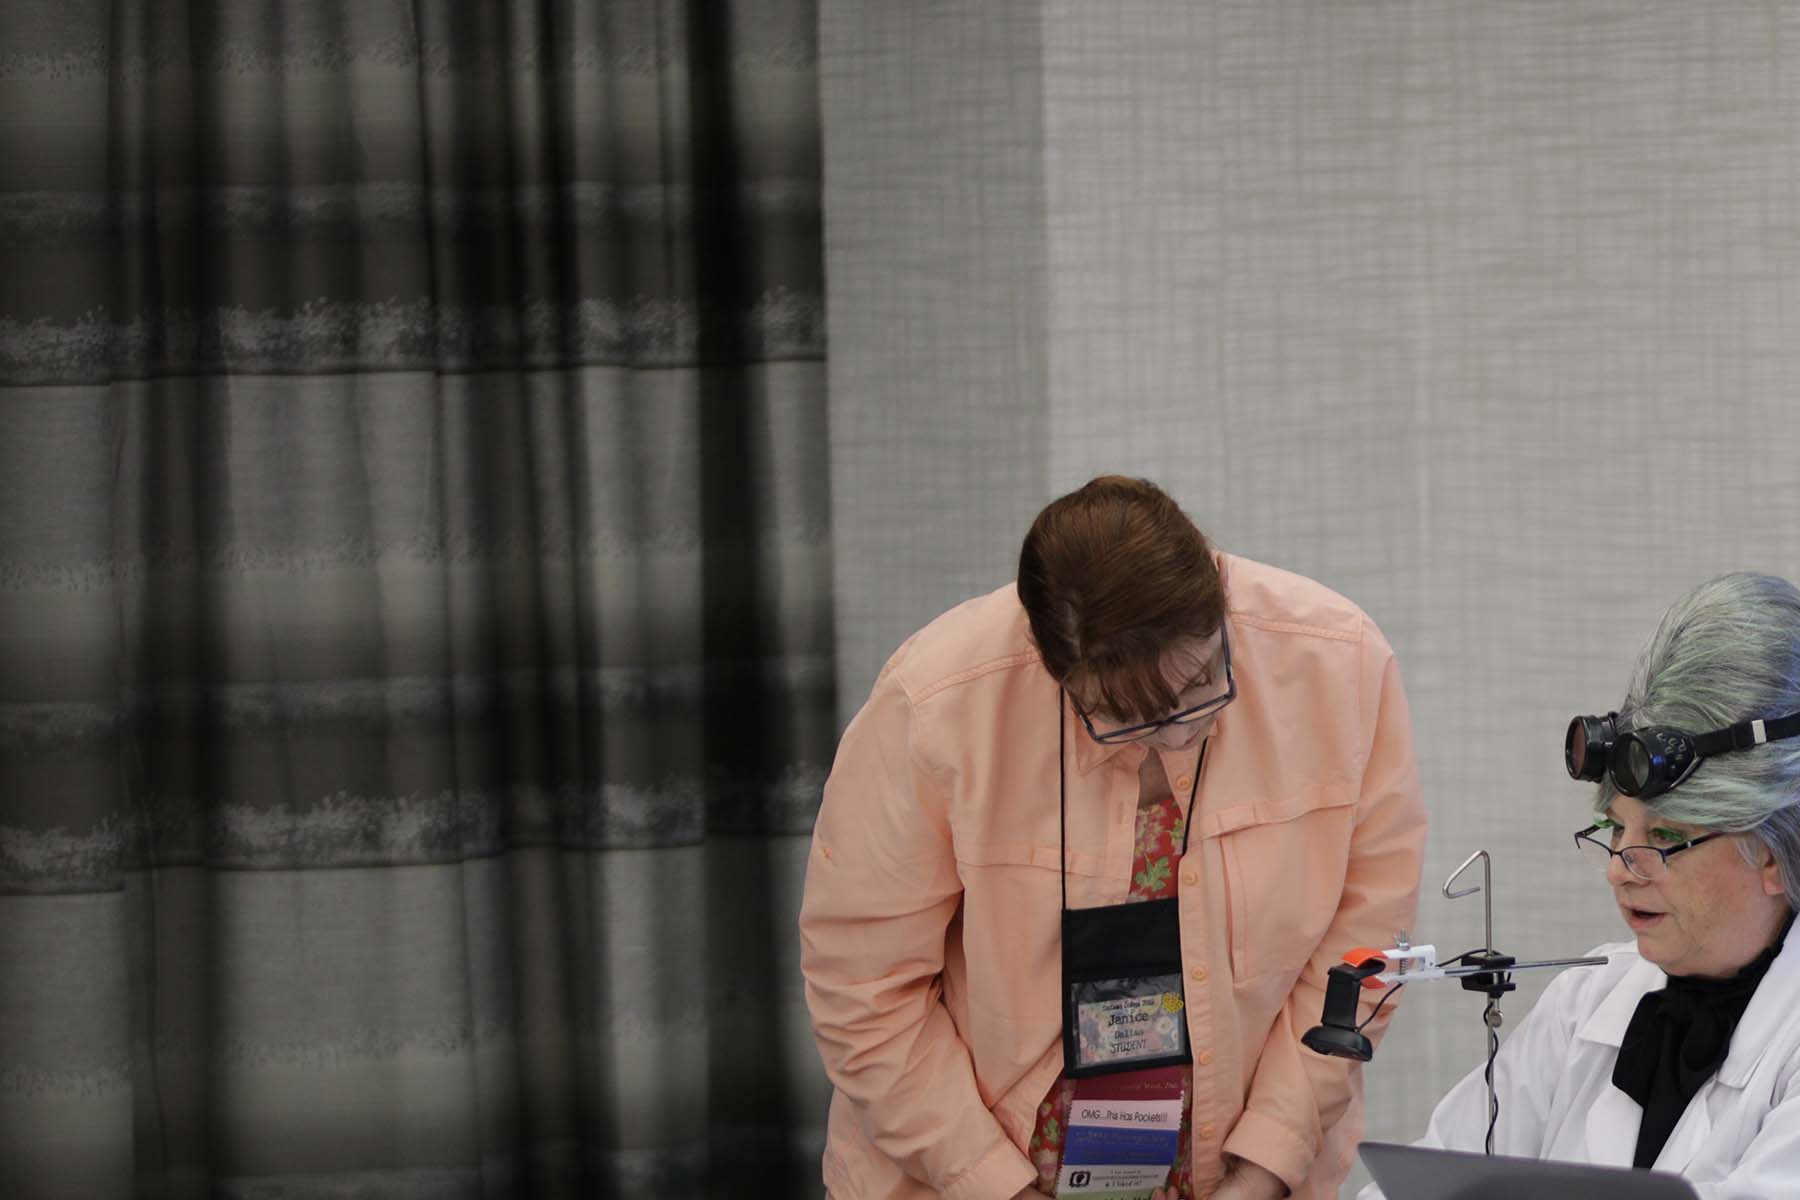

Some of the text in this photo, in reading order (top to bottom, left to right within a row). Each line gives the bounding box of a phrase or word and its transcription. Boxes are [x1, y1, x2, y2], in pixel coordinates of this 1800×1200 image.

[1108, 1012, 1149, 1026] Janice
[1111, 1039, 1147, 1053] STUDENT
[1119, 1110, 1133, 1121] Has
